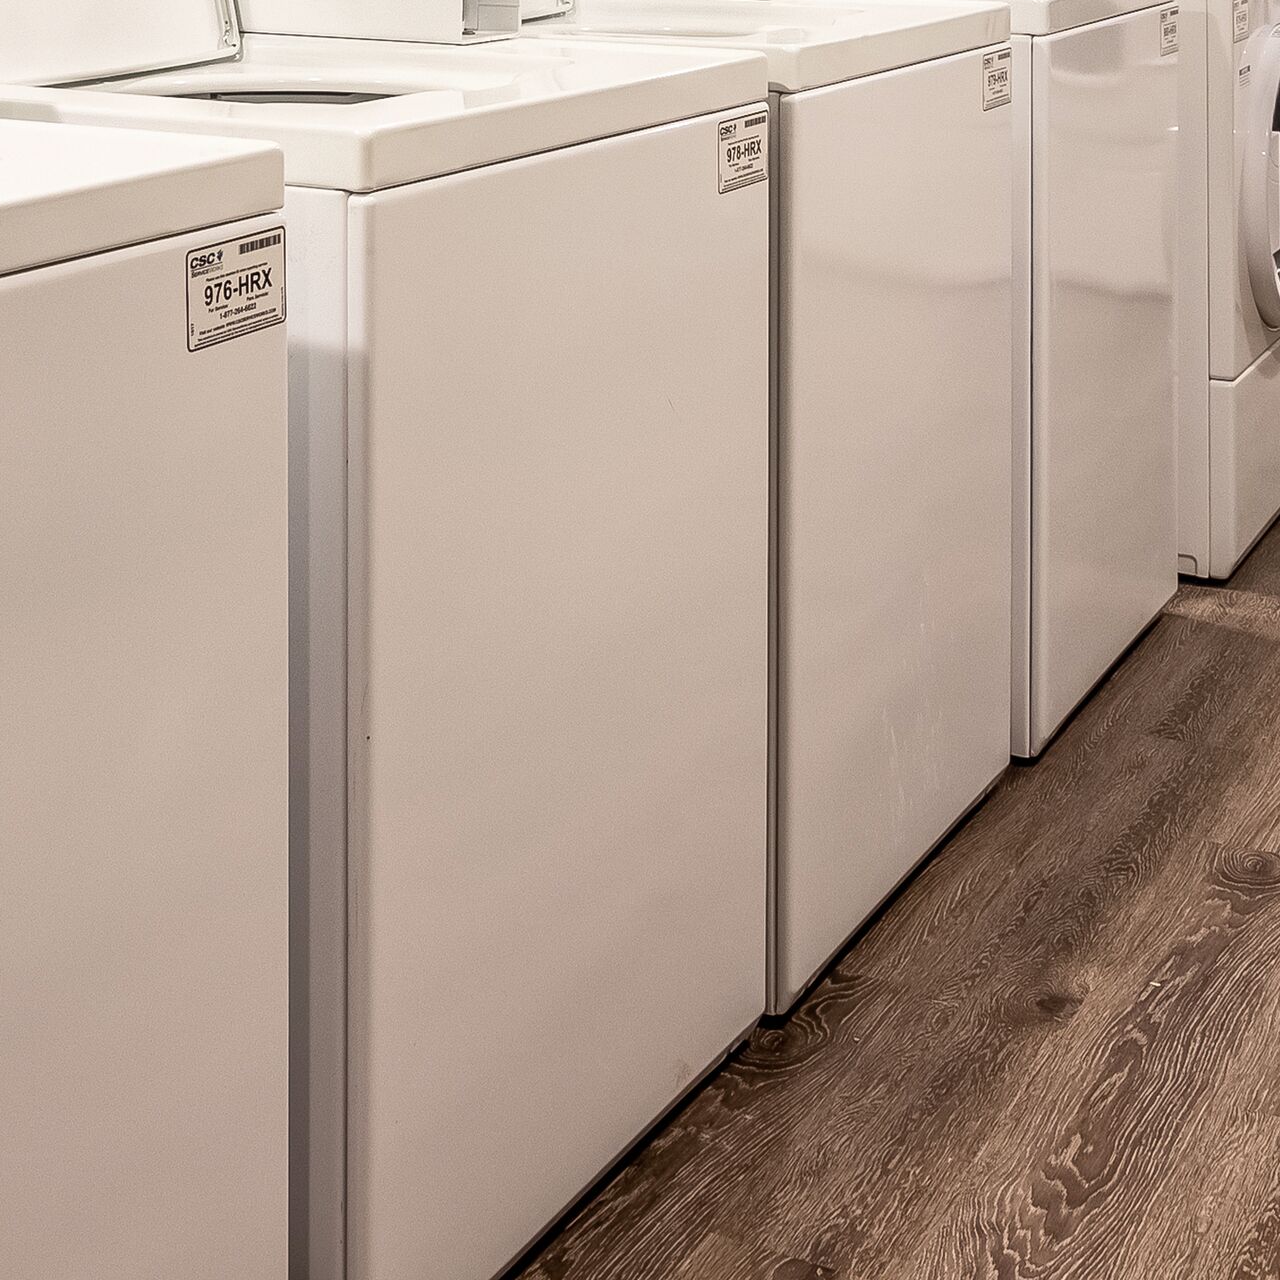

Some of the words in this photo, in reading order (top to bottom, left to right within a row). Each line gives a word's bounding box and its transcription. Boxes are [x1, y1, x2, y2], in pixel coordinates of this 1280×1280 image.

[726, 139, 762, 163] 978-HRX
[190, 253, 216, 269] CSC
[204, 267, 272, 306] 976-HRX
